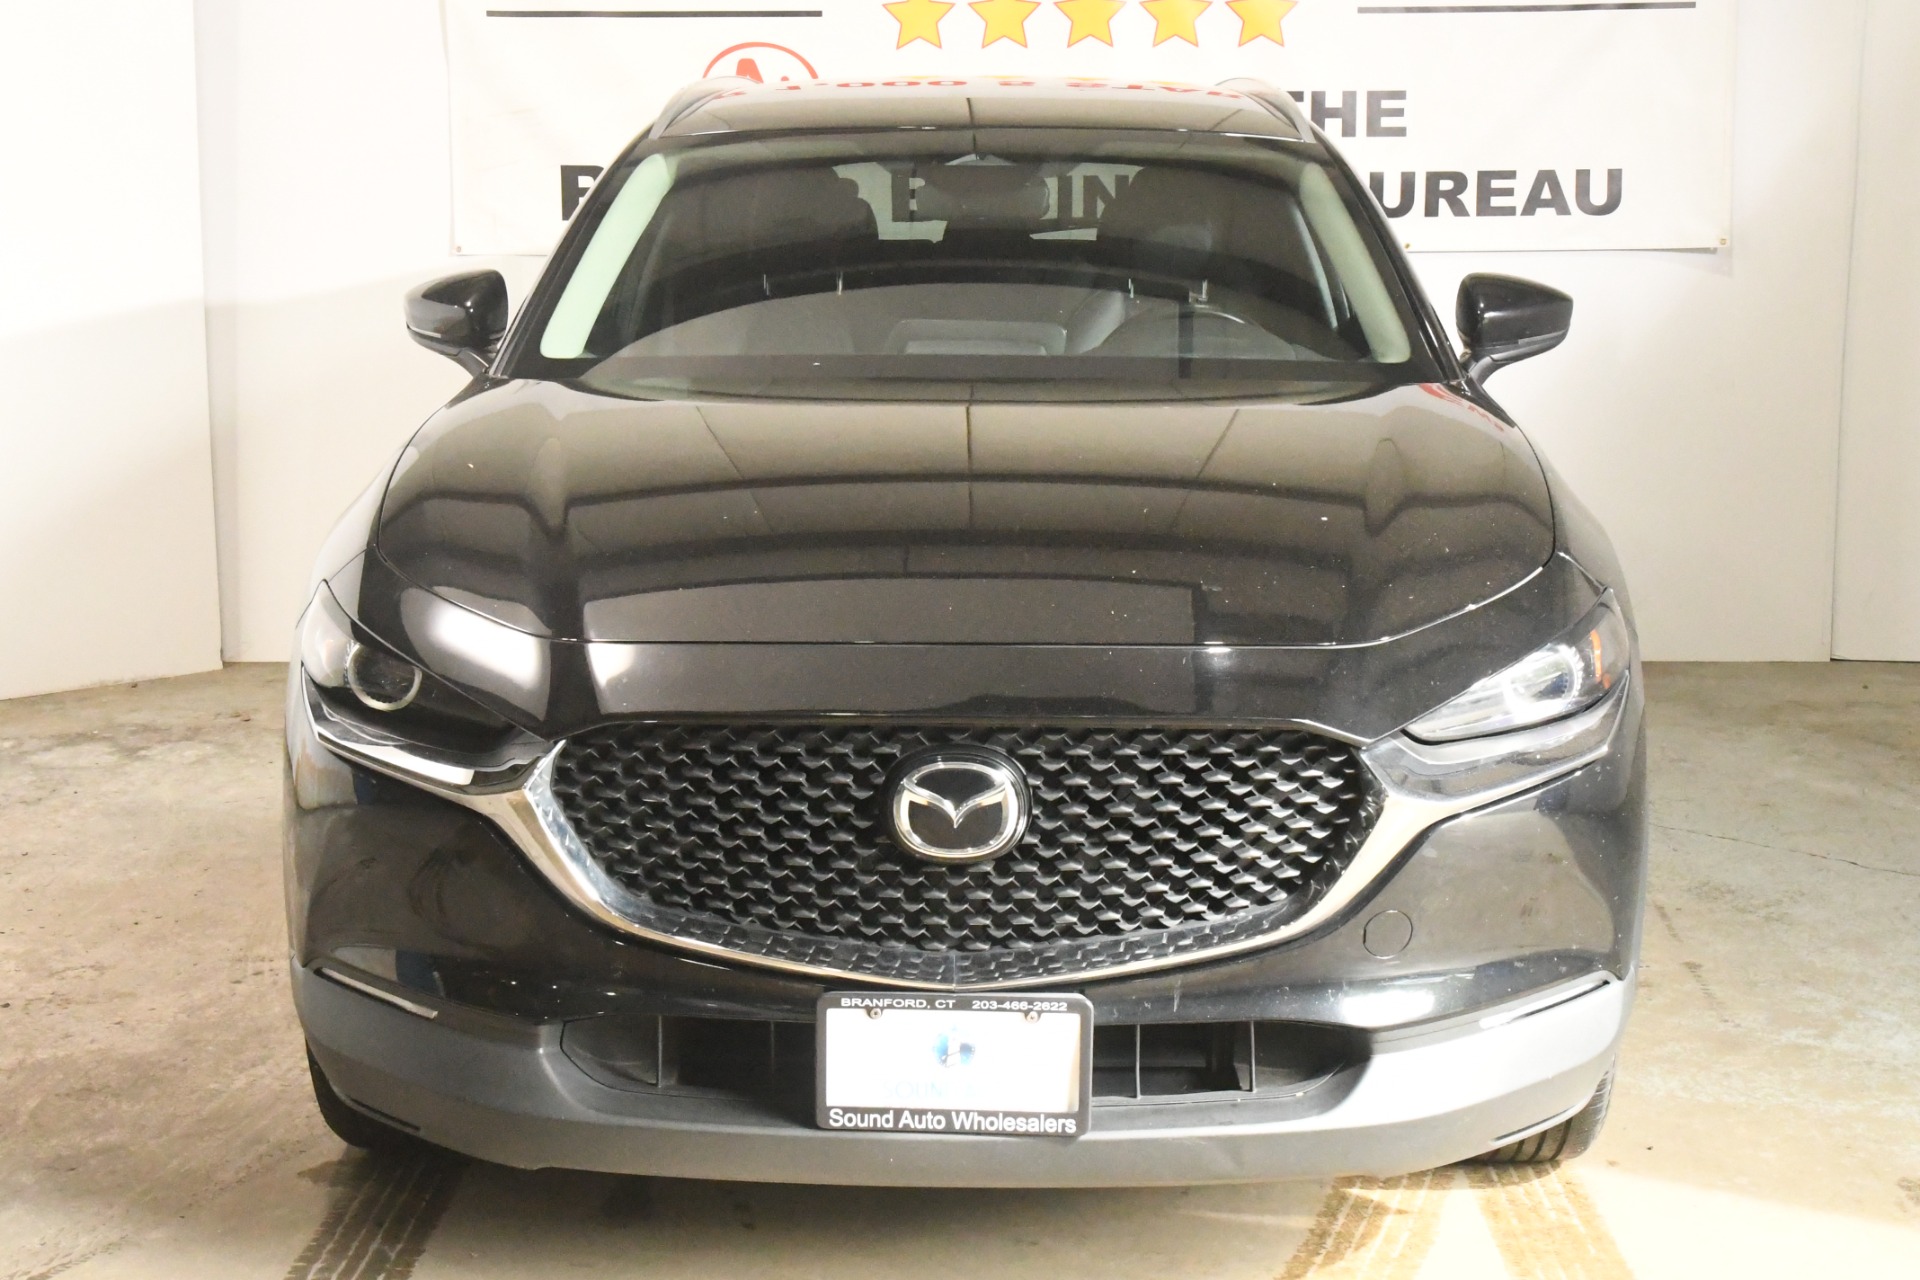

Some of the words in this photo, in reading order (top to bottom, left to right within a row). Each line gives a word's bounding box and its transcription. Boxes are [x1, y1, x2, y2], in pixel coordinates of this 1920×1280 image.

[1369, 168, 1623, 219] UREAU
[935, 999, 956, 1009] CT
[972, 1000, 1068, 1012] 203-466-2622
[829, 1108, 894, 1128] Sound
[898, 1110, 946, 1130] Auto
[952, 1111, 1077, 1133] Wholesalers
